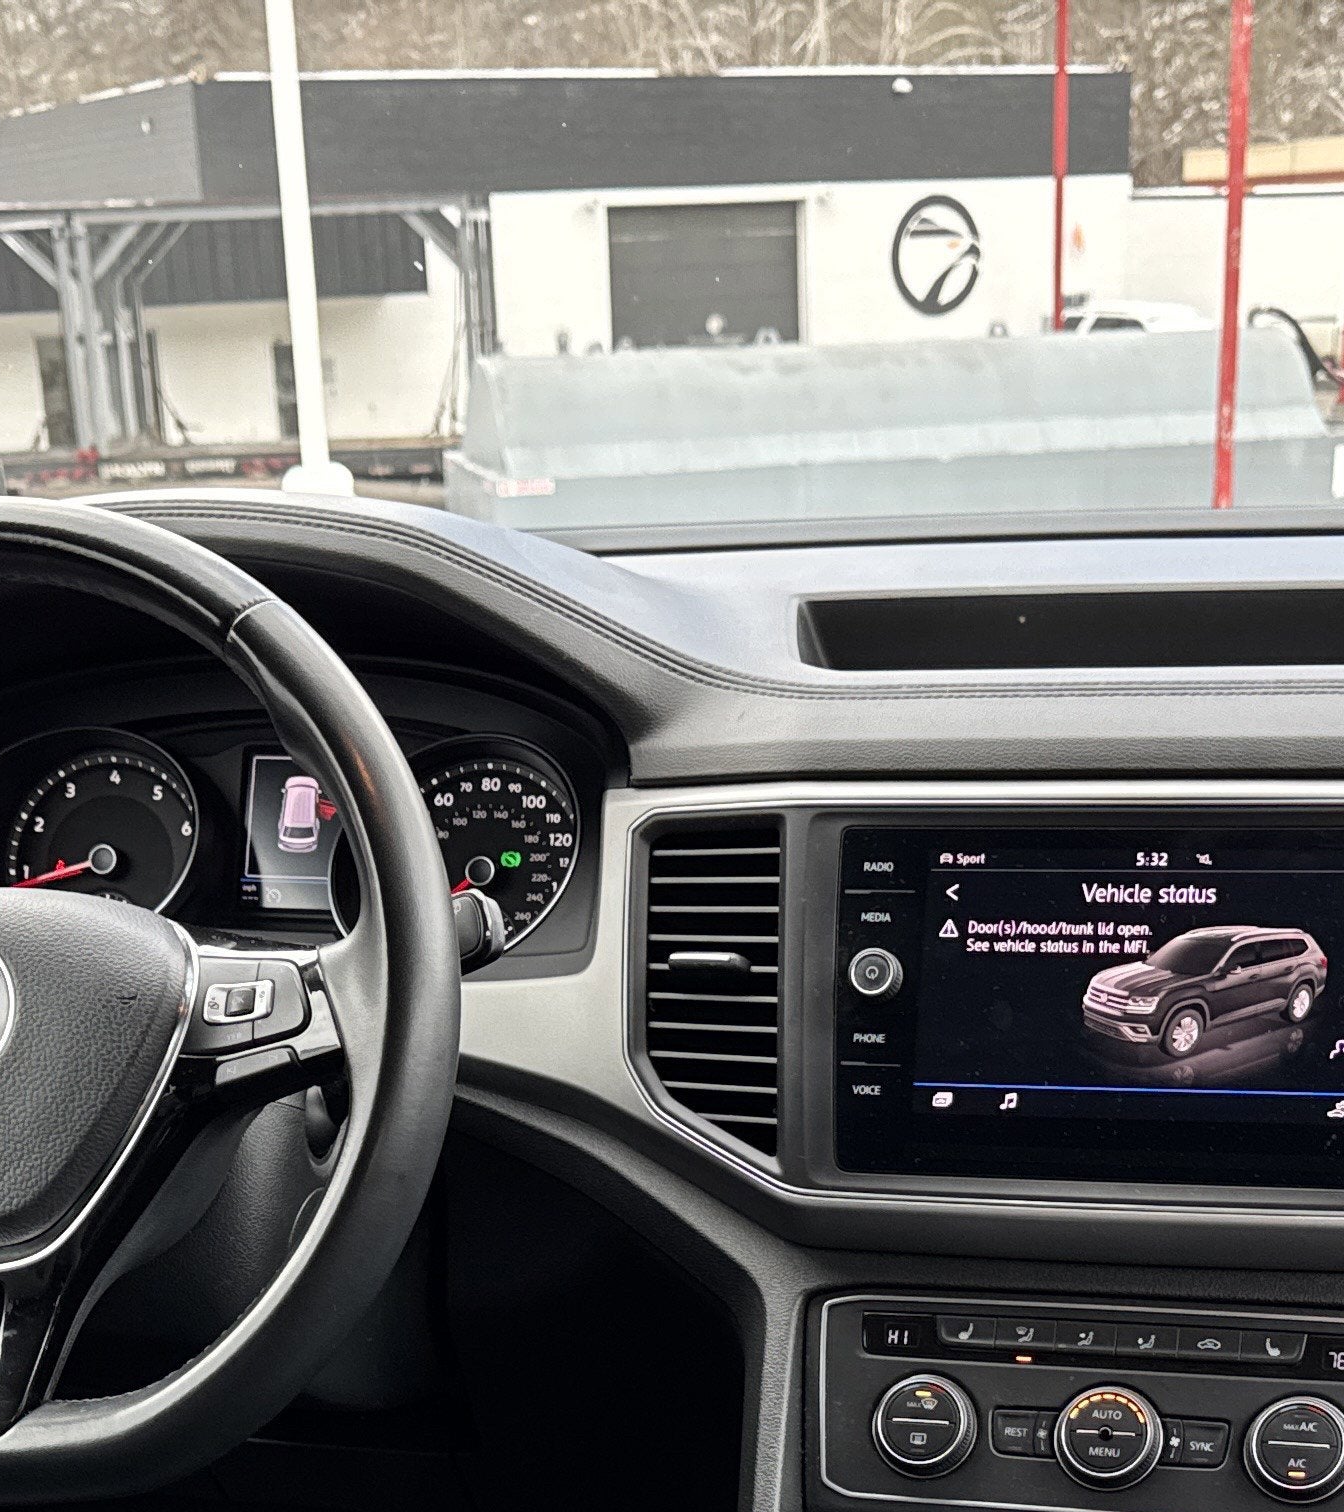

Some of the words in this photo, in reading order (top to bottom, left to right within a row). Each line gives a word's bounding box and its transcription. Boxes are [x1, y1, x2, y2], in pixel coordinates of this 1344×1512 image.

[109, 769, 122, 785] 4
[480, 776, 501, 792] 80
[64, 782, 77, 799] 3
[152, 784, 164, 801] 5
[459, 781, 473, 793] 70
[507, 782, 523, 794] 90
[433, 792, 455, 807] 60
[521, 795, 547, 809] 100
[33, 816, 45, 833] 2
[545, 813, 562, 824] 110
[180, 820, 193, 837] 6
[548, 832, 573, 848] 120
[956, 853, 986, 867] Sport
[1135, 852, 1169, 867] 5:32
[863, 861, 895, 873] RADIO
[1081, 883, 1152, 904] Vehicle
[1157, 884, 1218, 904] status
[860, 911, 892, 923] MEDIA
[966, 919, 1095, 937] Door(s)/hood/trunk
[1096, 921, 1115, 936] lid
[1116, 924, 1154, 939] open.
[965, 938, 990, 953] See
[992, 938, 1038, 953] vehicle
[1039, 939, 1081, 954] status
[1081, 939, 1095, 954] in
[1096, 940, 1120, 954] the
[1123, 940, 1151, 955] MFI.
[852, 1032, 886, 1044] PHONE
[851, 1084, 882, 1096] VOICE
[1091, 1409, 1123, 1420] AUTO
[1004, 1427, 1029, 1438] REST
[1299, 1421, 1319, 1433] A/C
[1088, 1446, 1121, 1458] MENU
[1189, 1440, 1215, 1453] SYNC
[1287, 1457, 1307, 1469] A/C
